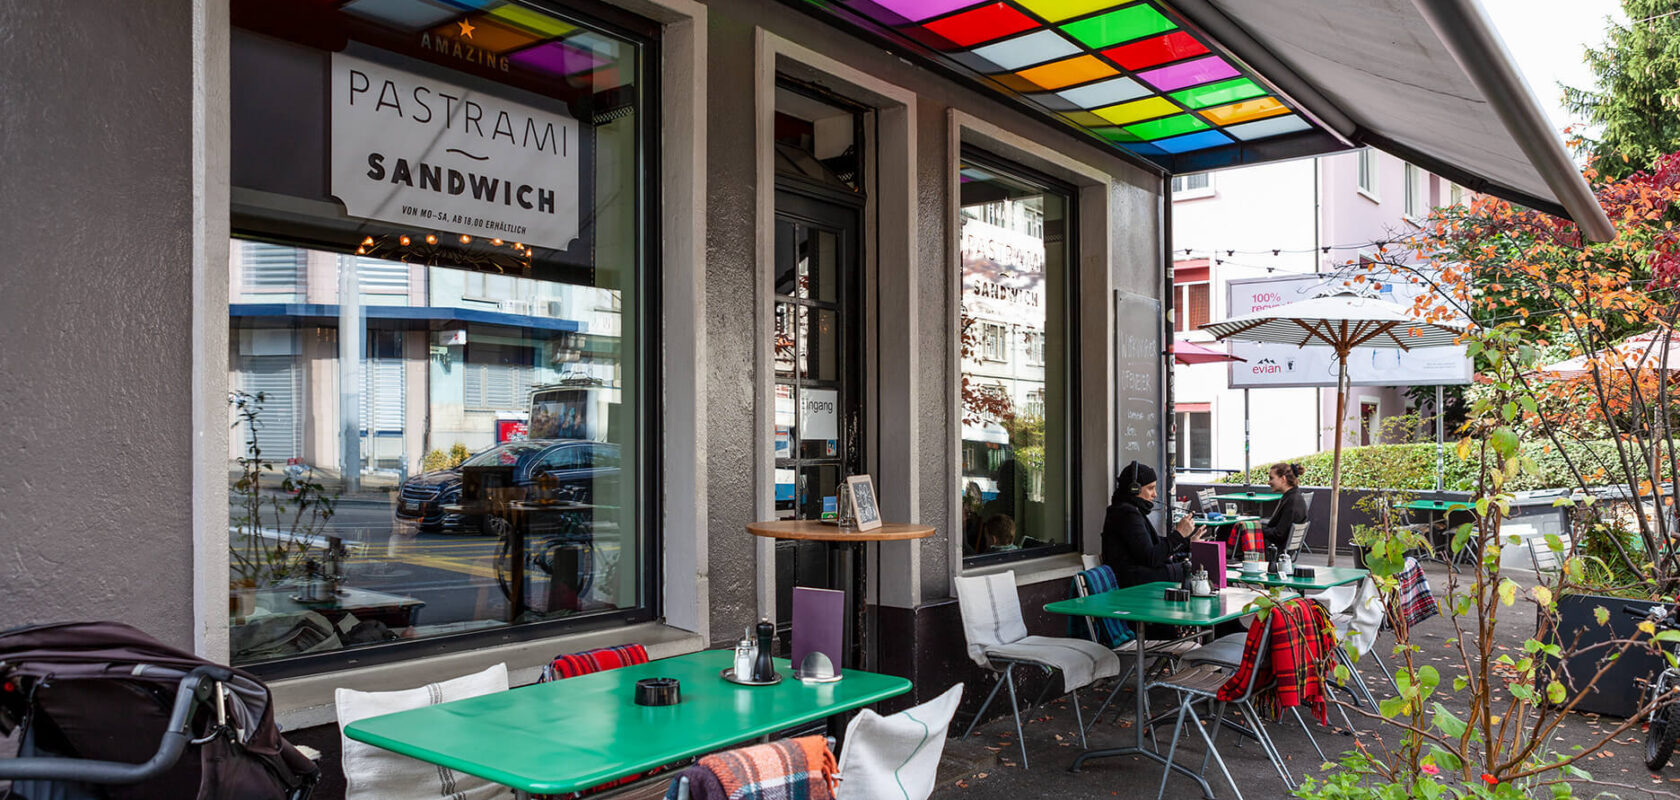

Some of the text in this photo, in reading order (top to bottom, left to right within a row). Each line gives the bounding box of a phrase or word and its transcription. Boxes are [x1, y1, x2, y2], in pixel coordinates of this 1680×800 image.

[421, 32, 509, 72] AMAZING
[349, 69, 568, 158] PASTRAMI
[366, 152, 555, 214] SANDWICH
[402, 205, 418, 216] VON
[452, 214, 463, 224] AB
[485, 220, 527, 235] ERHÄLTLICH
[973, 280, 1040, 307] SANDWICH
[1251, 292, 1281, 303] 100%
[1252, 364, 1282, 374] evian
